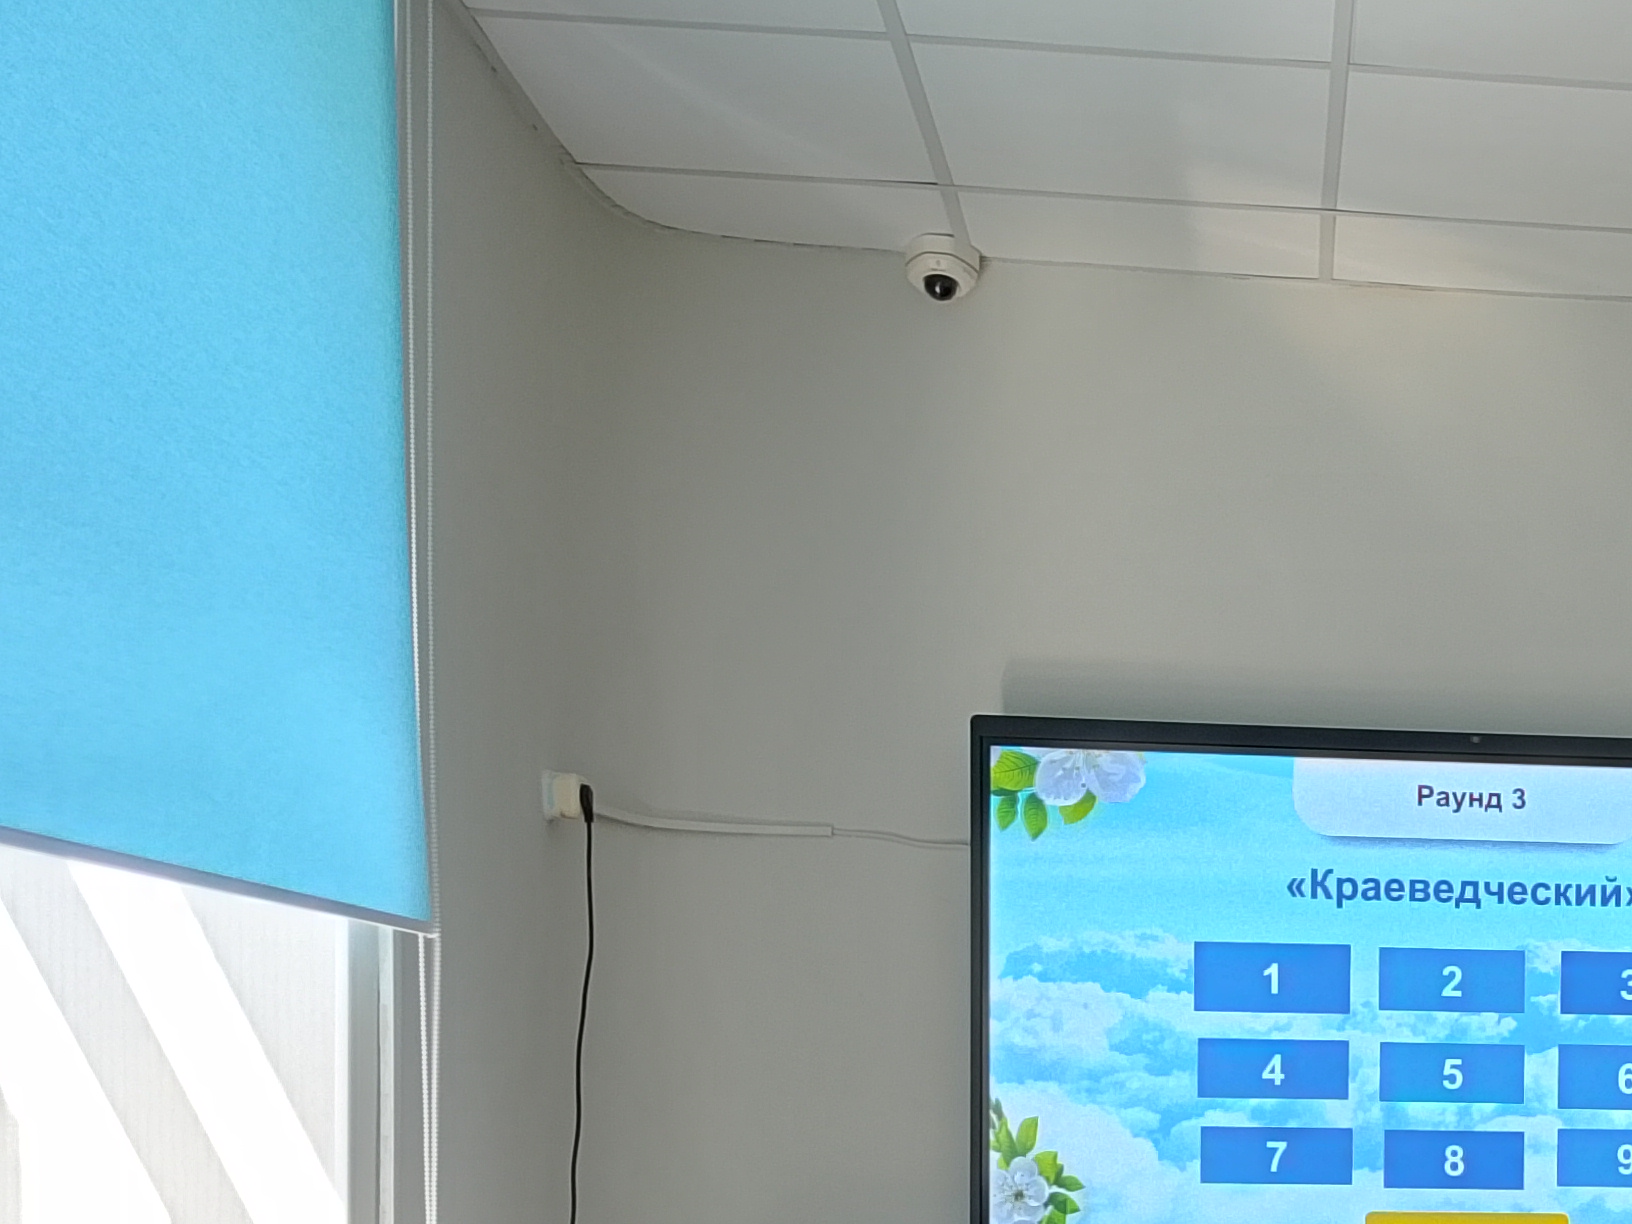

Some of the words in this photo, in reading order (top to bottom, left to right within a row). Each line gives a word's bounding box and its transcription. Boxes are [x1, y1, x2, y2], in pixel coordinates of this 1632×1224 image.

[1416, 784, 1503, 813] Раунд
[1511, 787, 1528, 810] 3
[1263, 963, 1279, 994] 1
[1442, 965, 1463, 997] 2
[1262, 1054, 1285, 1086] 4
[1443, 1058, 1463, 1090] 5
[1266, 1141, 1287, 1172] 7
[1444, 1145, 1465, 1177] 8
